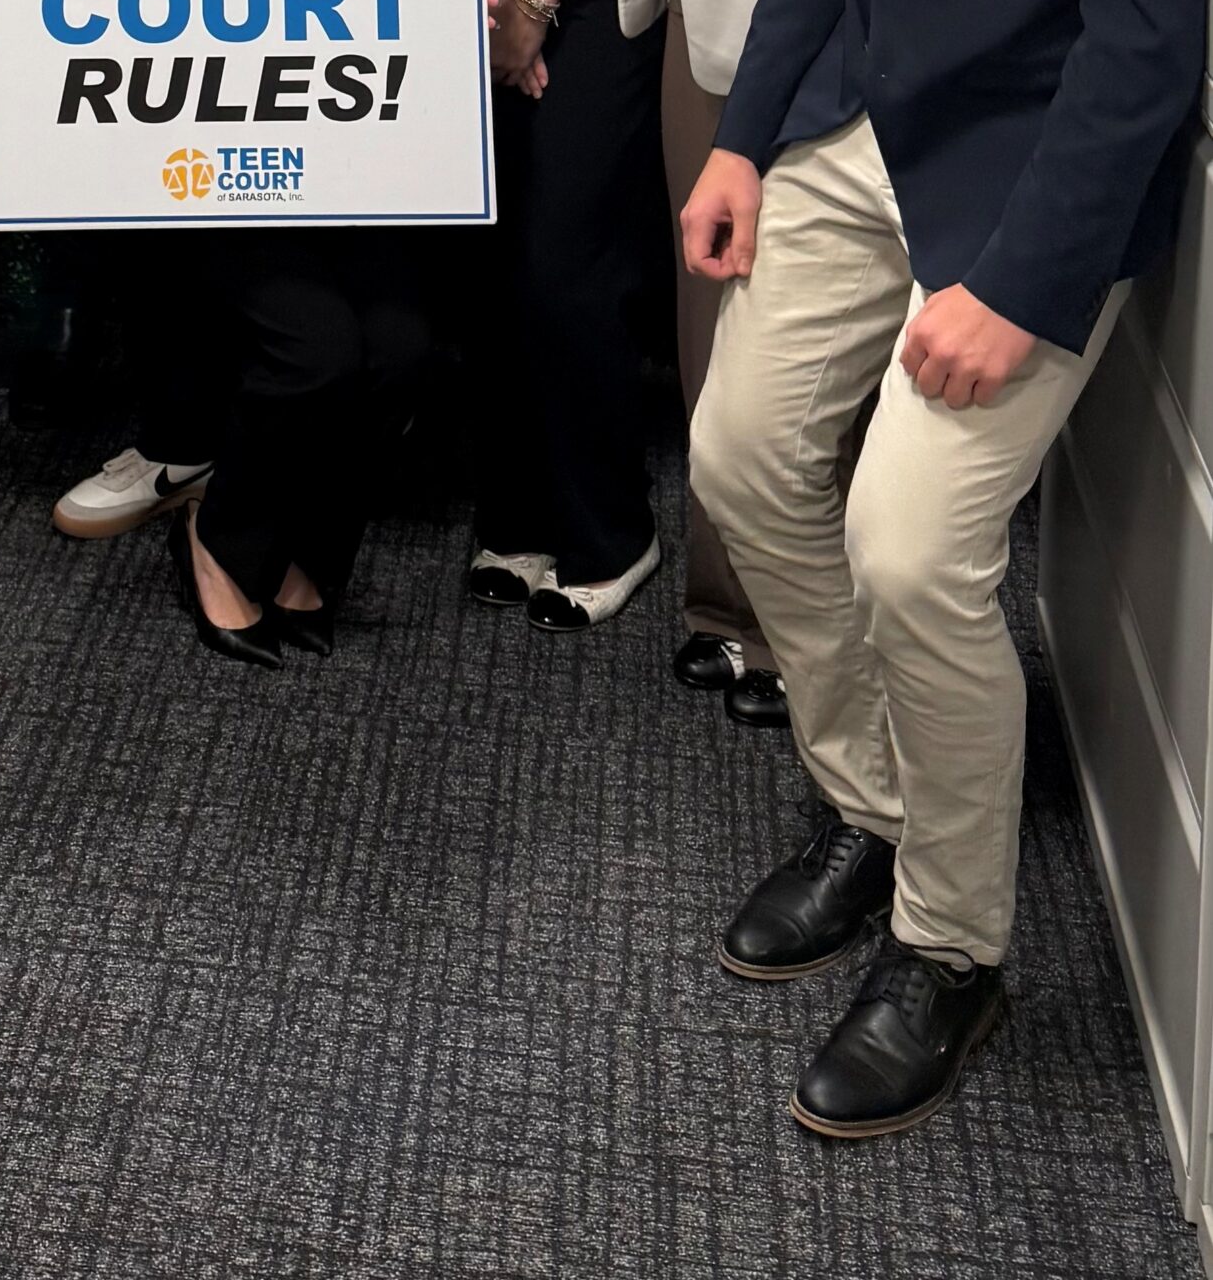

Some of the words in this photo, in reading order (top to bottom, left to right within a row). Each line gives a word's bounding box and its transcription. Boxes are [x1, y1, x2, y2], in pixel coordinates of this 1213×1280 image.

[57, 54, 409, 125] RULES!
[217, 147, 304, 171] TEEN
[217, 172, 304, 191] COURT
[217, 193, 227, 201] of
[228, 192, 286, 202] SARASOTA,
[288, 192, 305, 201] Inc.
